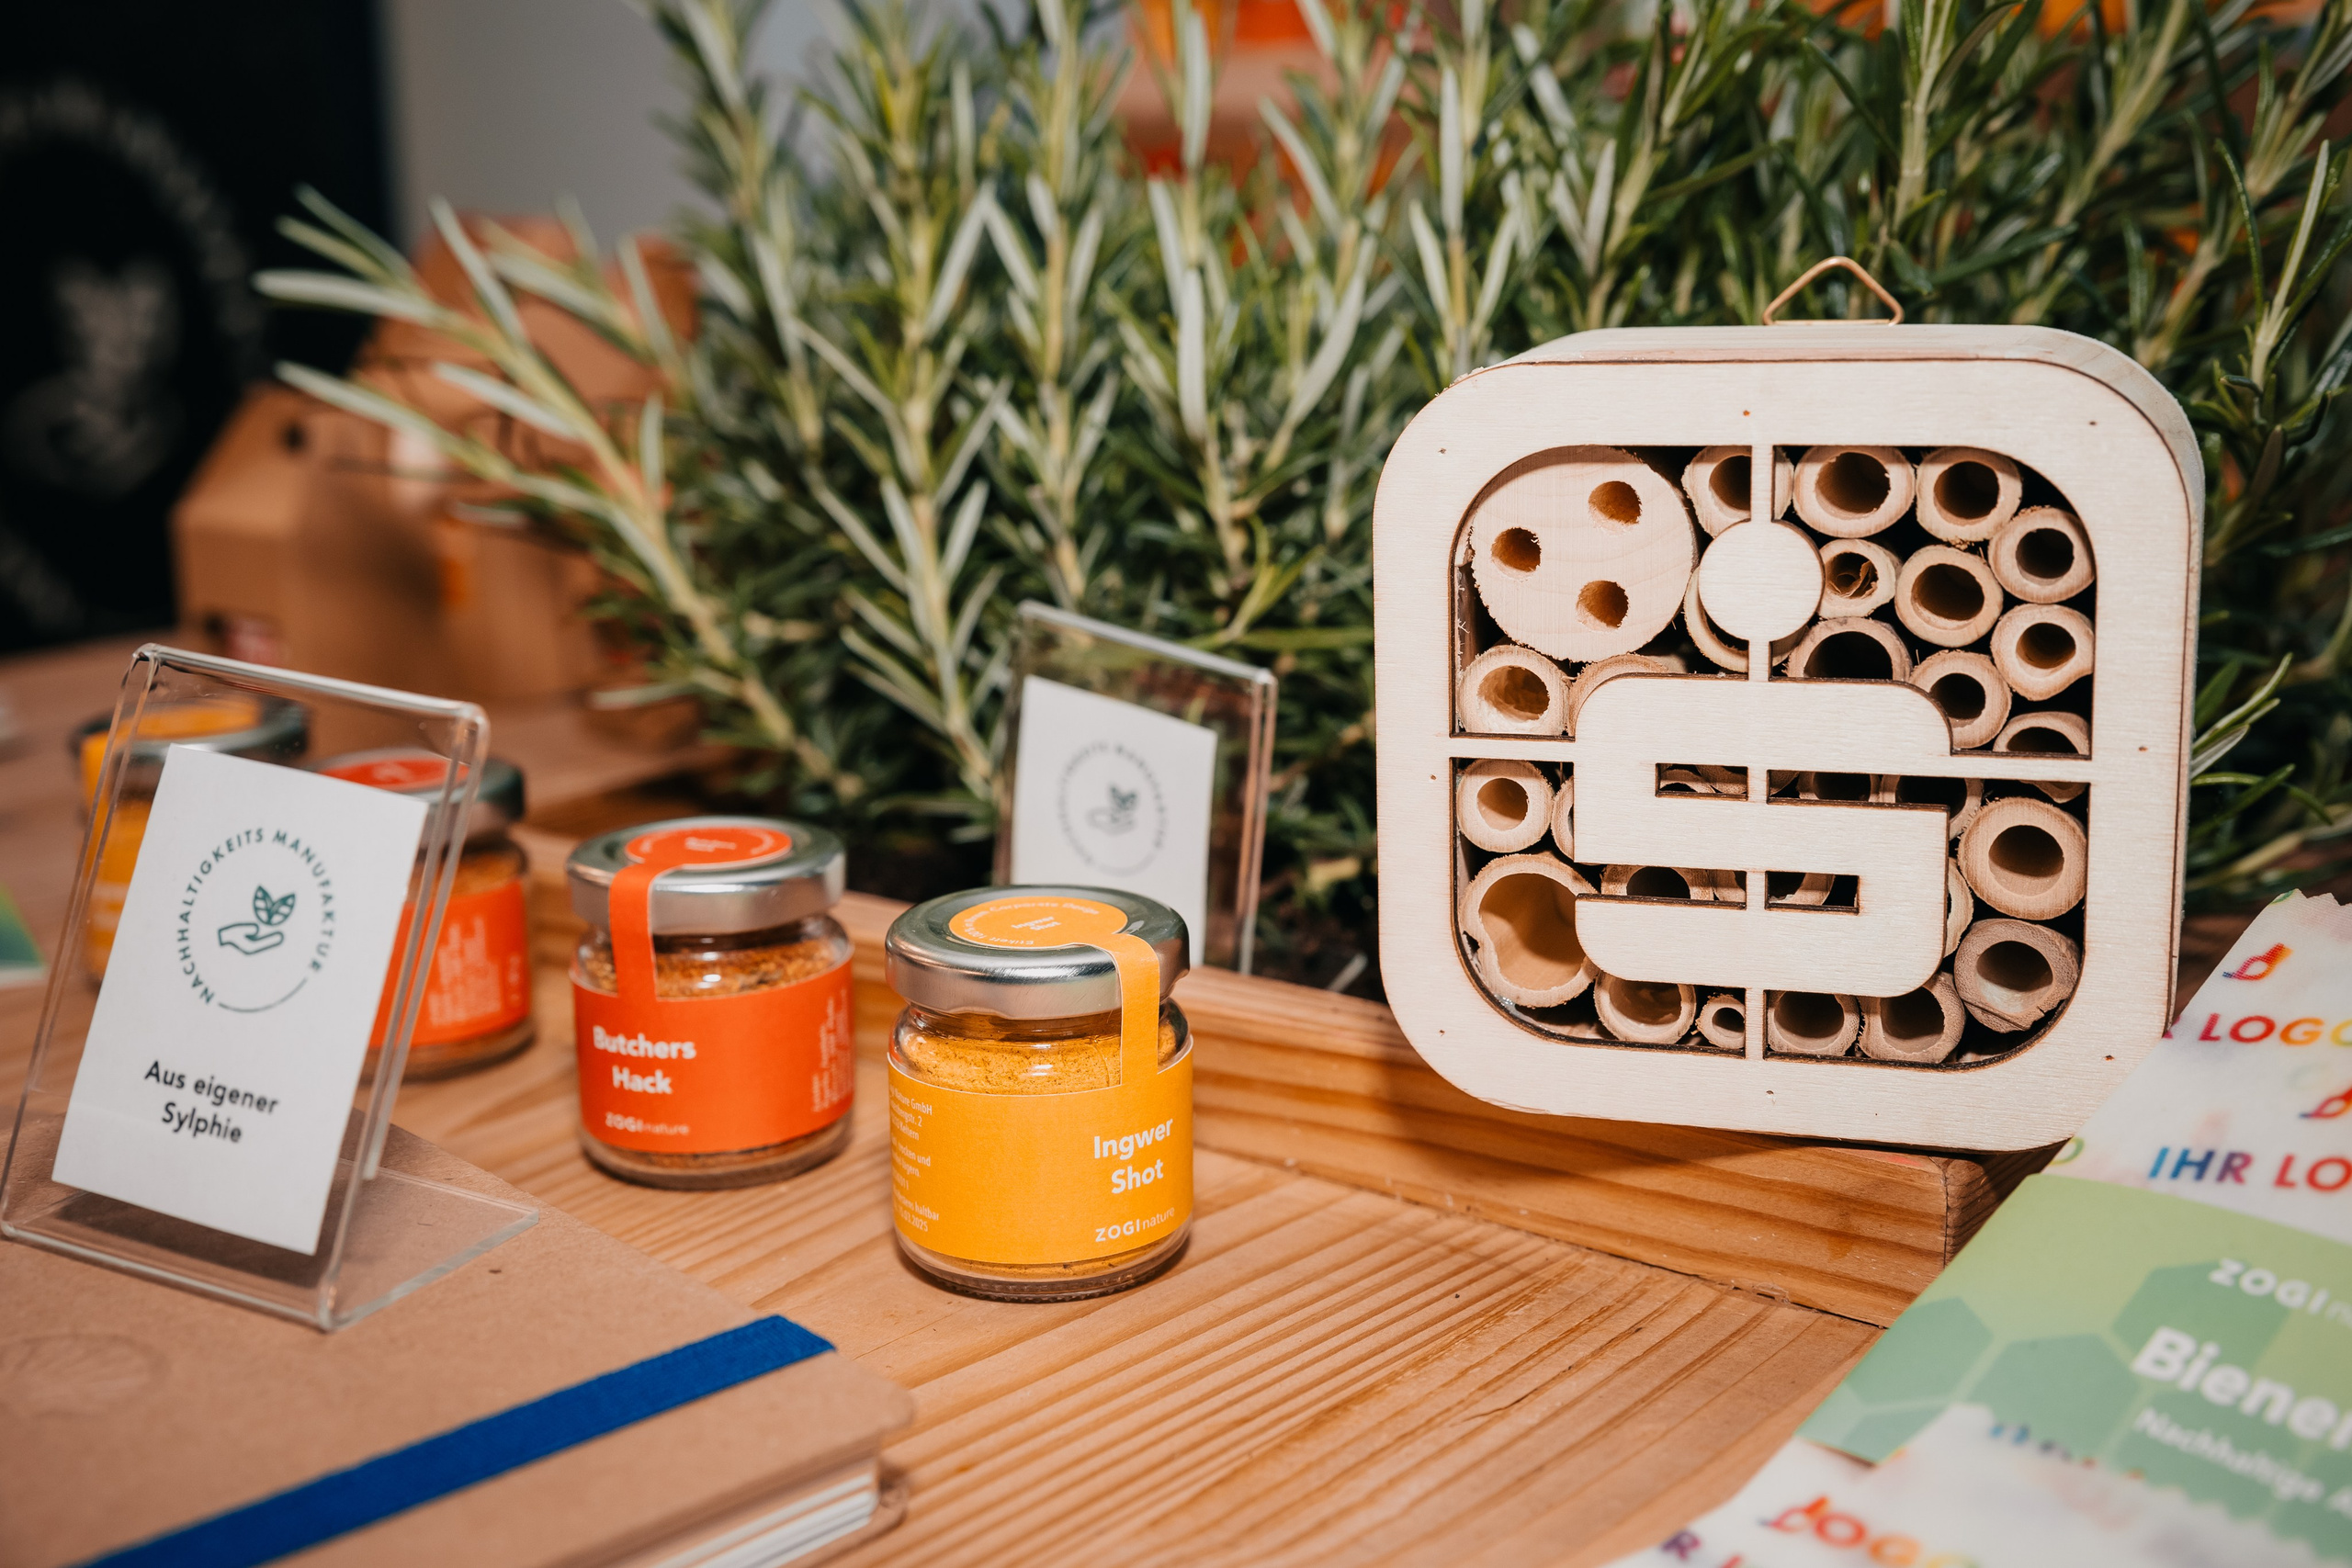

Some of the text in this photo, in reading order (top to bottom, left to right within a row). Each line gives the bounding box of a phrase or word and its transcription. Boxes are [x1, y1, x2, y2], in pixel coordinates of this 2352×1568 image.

[177, 829, 264, 1004] NACHHALTIGKEITS
[273, 830, 334, 972] MANUFAKTUR
[593, 1025, 696, 1059] Butchers
[145, 1060, 278, 1113] Aus eigener
[612, 1066, 673, 1094] Hack
[162, 1101, 242, 1143] Sylphie
[910, 1098, 933, 1116] GmbH
[917, 1115, 922, 1127] 2
[1094, 1119, 1173, 1160] Ingwer
[917, 1155, 932, 1168] und
[1112, 1158, 1164, 1194] Shot
[2149, 1146, 2254, 1185] IHR
[914, 1201, 940, 1221] haltbar
